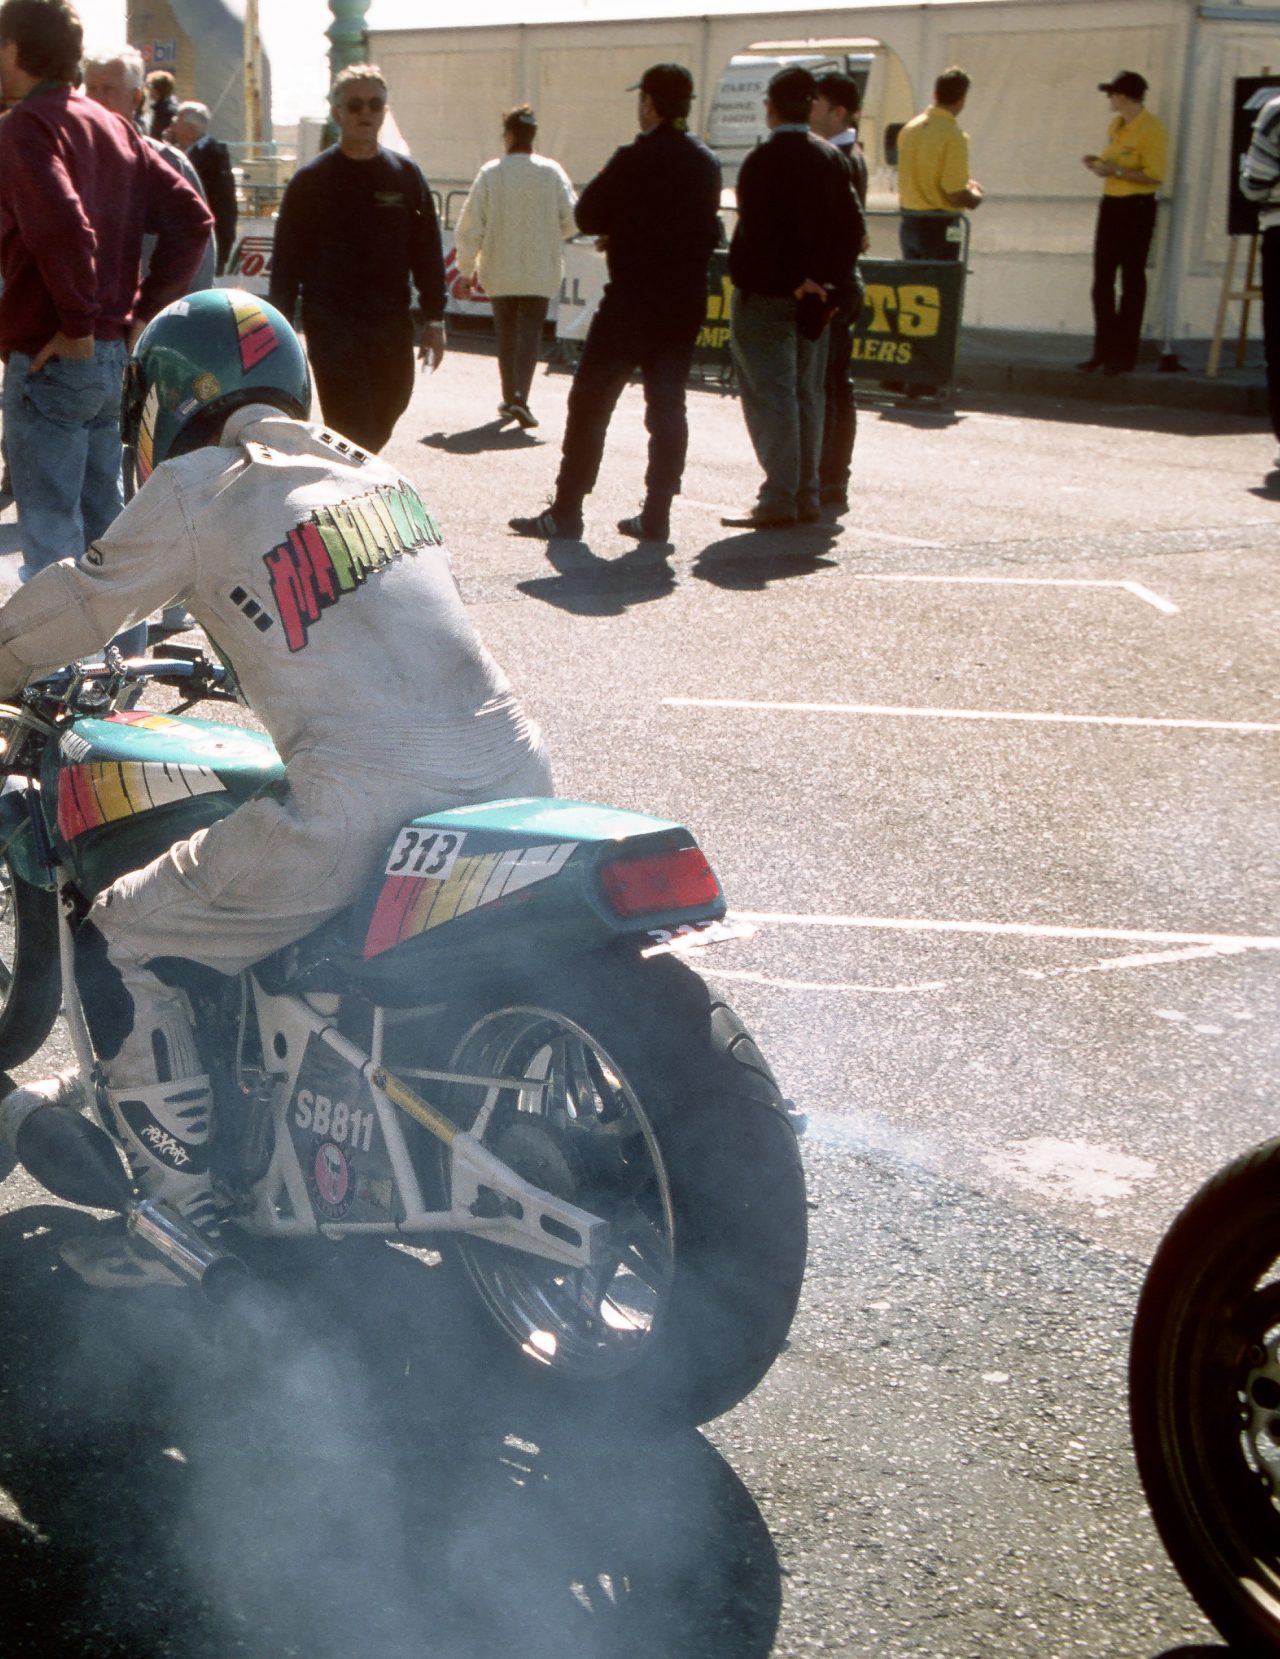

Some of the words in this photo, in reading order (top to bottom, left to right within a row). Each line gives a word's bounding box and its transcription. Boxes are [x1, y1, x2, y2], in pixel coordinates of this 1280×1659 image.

[140, 38, 177, 63] obil
[390, 831, 458, 875] 313
[295, 1089, 374, 1152] SB811
